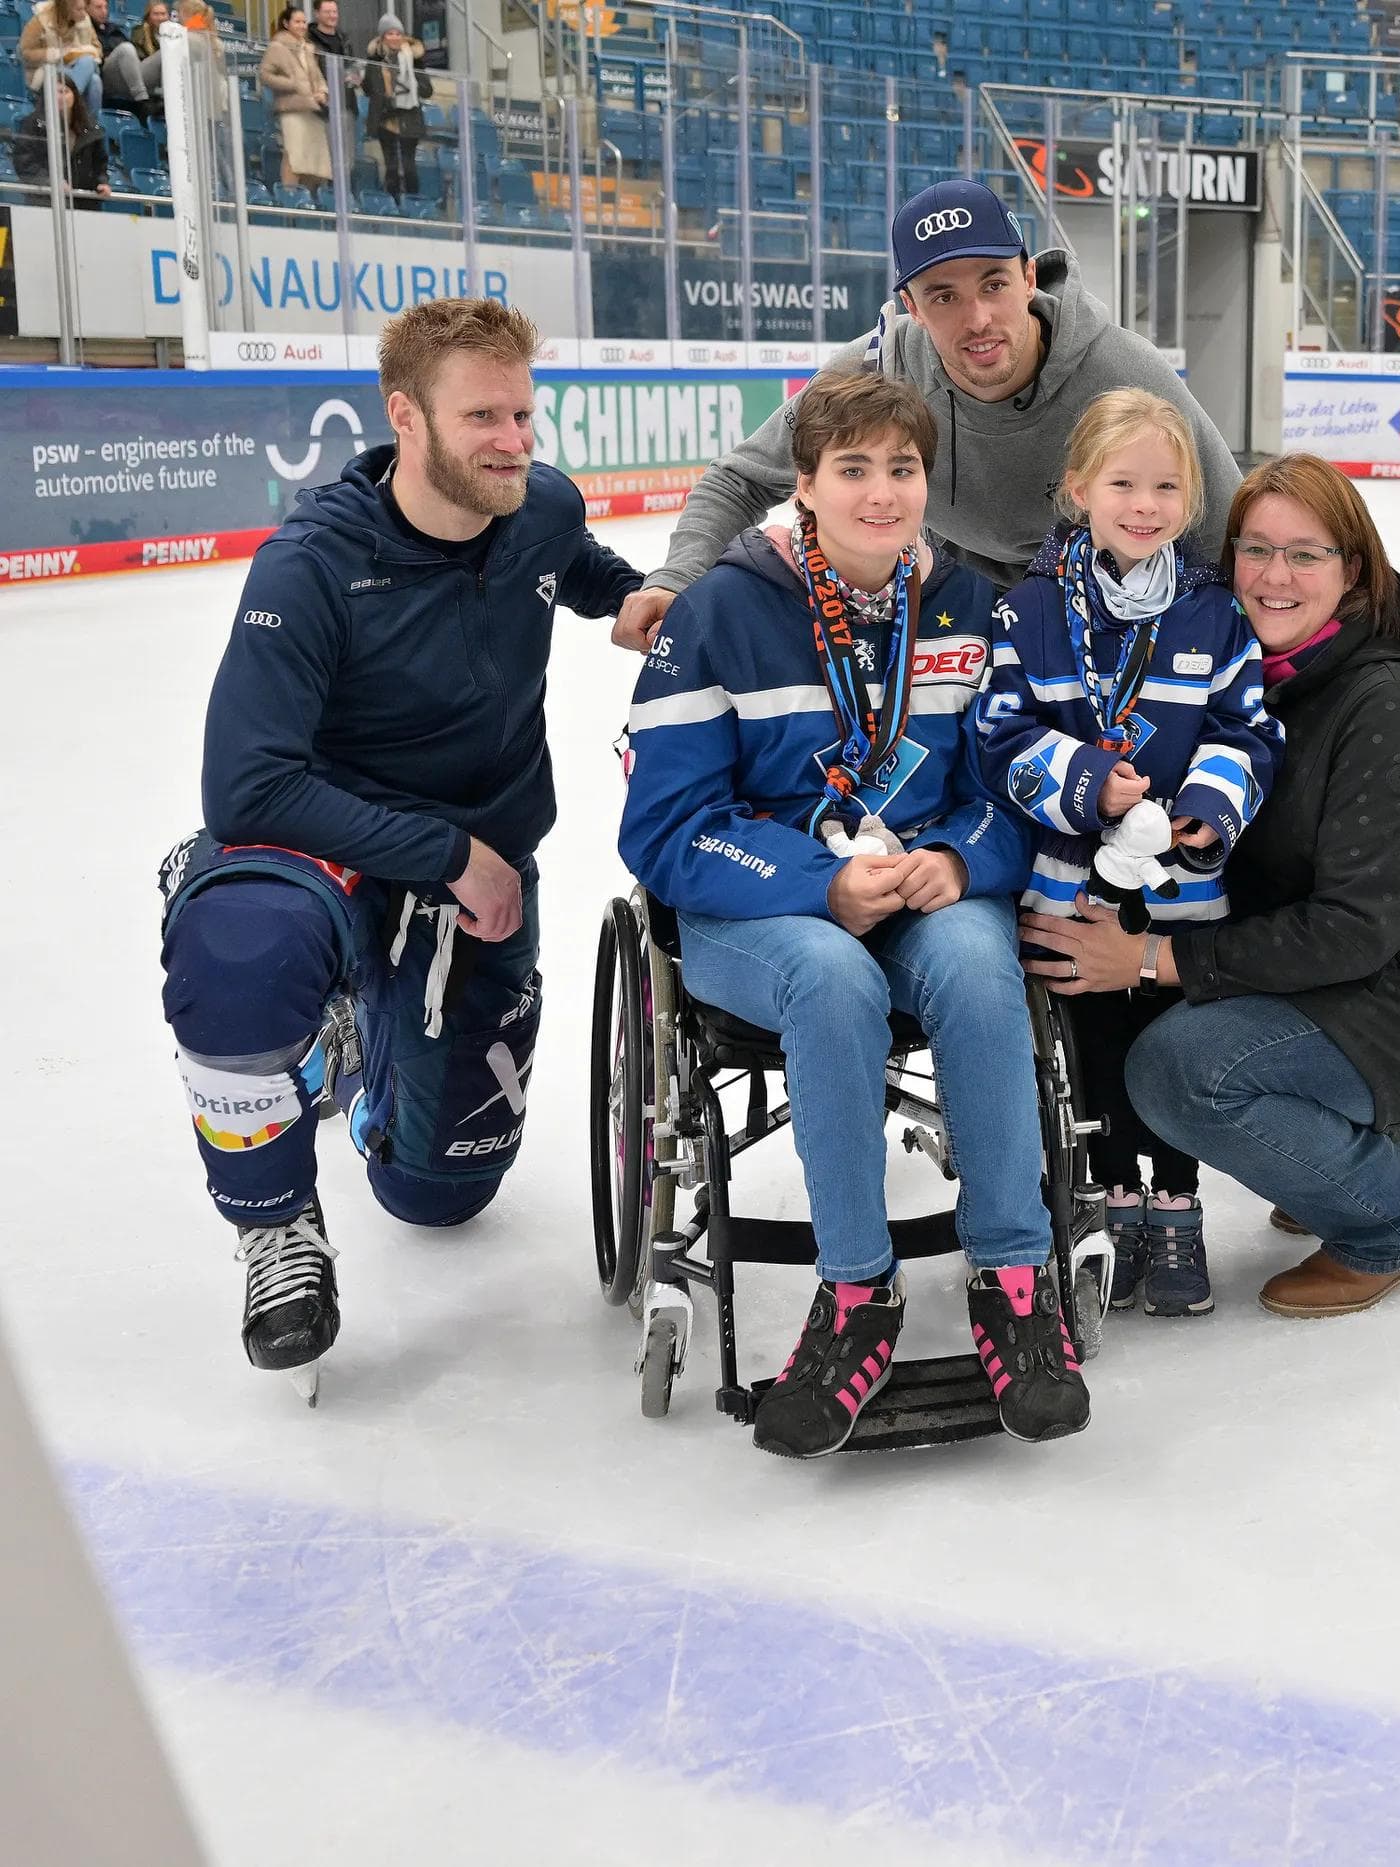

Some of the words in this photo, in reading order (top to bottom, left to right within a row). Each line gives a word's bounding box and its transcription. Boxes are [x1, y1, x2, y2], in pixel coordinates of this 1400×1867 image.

[1097, 147, 1247, 202] SATURN
[684, 279, 849, 310] VOLKSWAGEN
[284, 344, 322, 360] Audi
[538, 347, 559, 361] udi
[628, 348, 655, 362] Audi
[714, 349, 737, 361] Audi
[787, 350, 811, 361] Audi
[1336, 359, 1368, 369] Audi
[533, 385, 743, 470] SCHIMMER
[33, 443, 80, 472] psw
[101, 435, 196, 468] engineers
[201, 433, 222, 457] of
[224, 432, 256, 456] the
[35, 468, 154, 498] automotive
[158, 466, 217, 489] future
